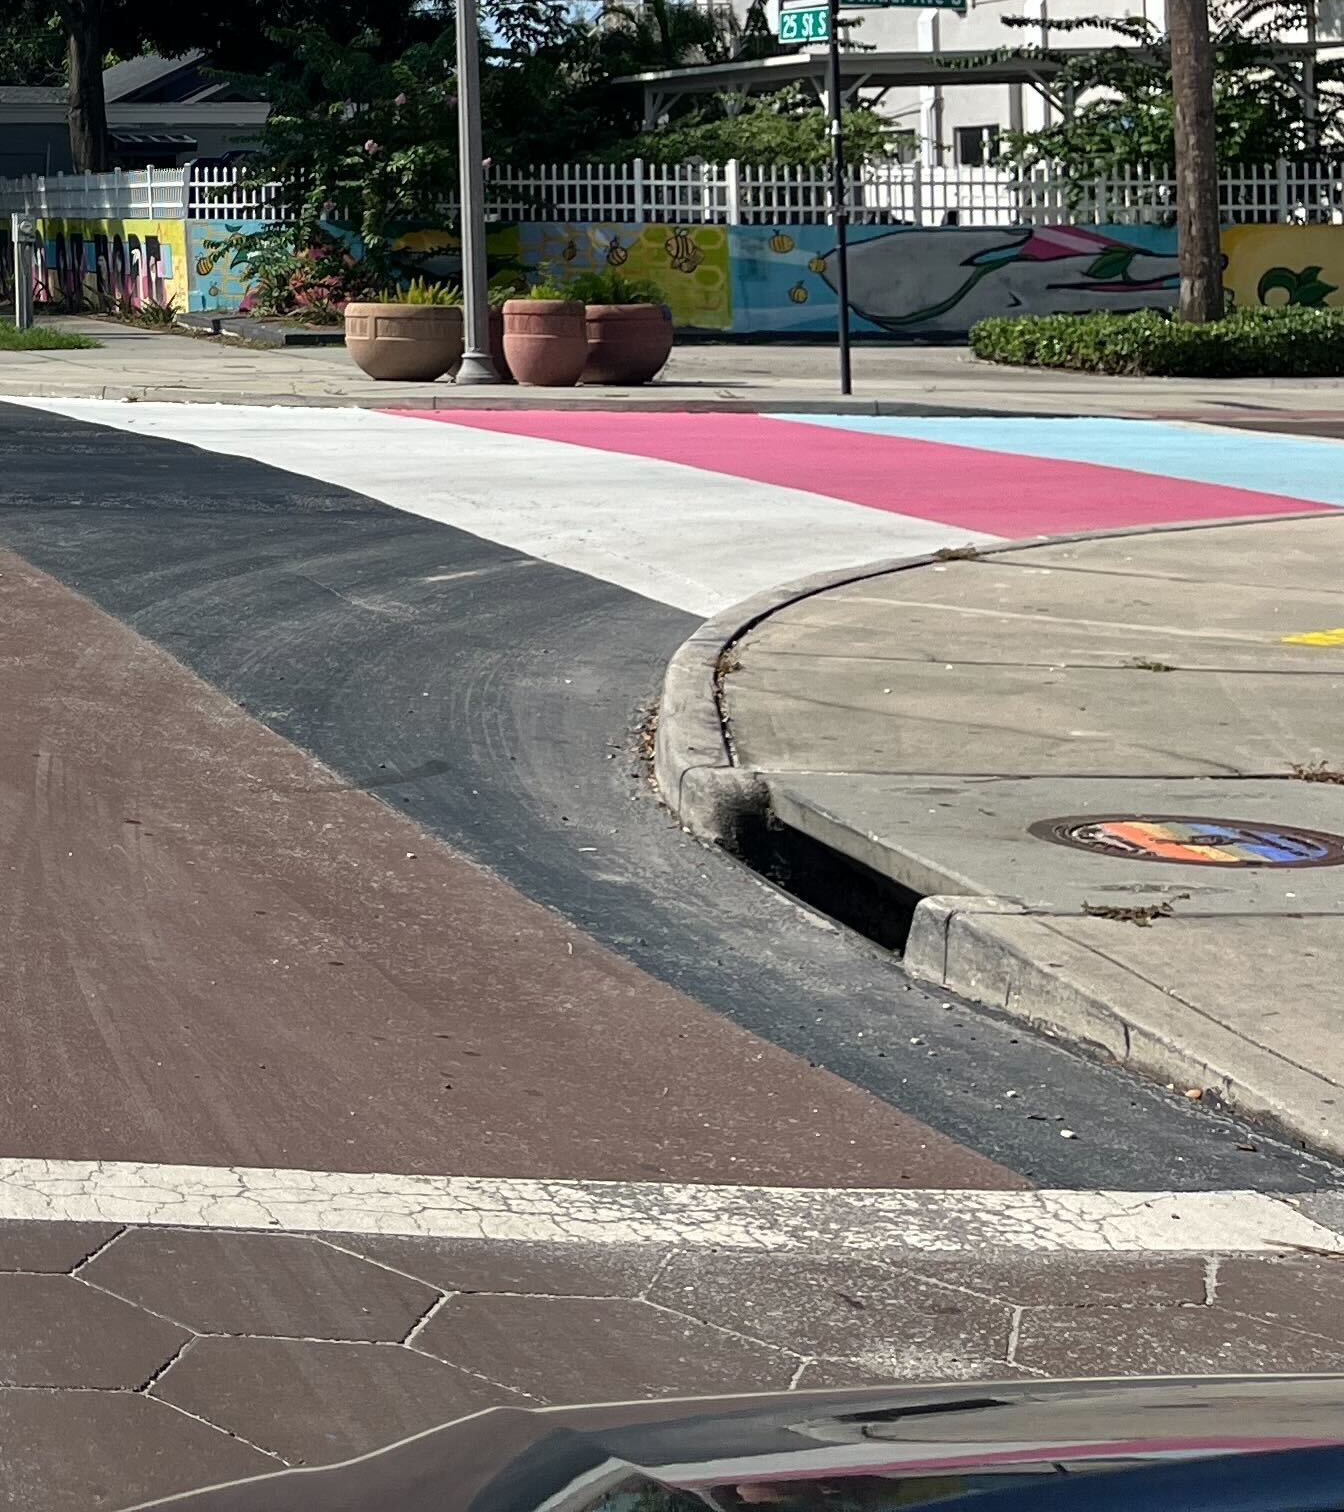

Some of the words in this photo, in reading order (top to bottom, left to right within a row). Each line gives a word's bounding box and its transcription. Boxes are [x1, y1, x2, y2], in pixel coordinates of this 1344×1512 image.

[782, 14, 798, 39] 25
[801, 12, 814, 37] St
[818, 11, 827, 36] S
